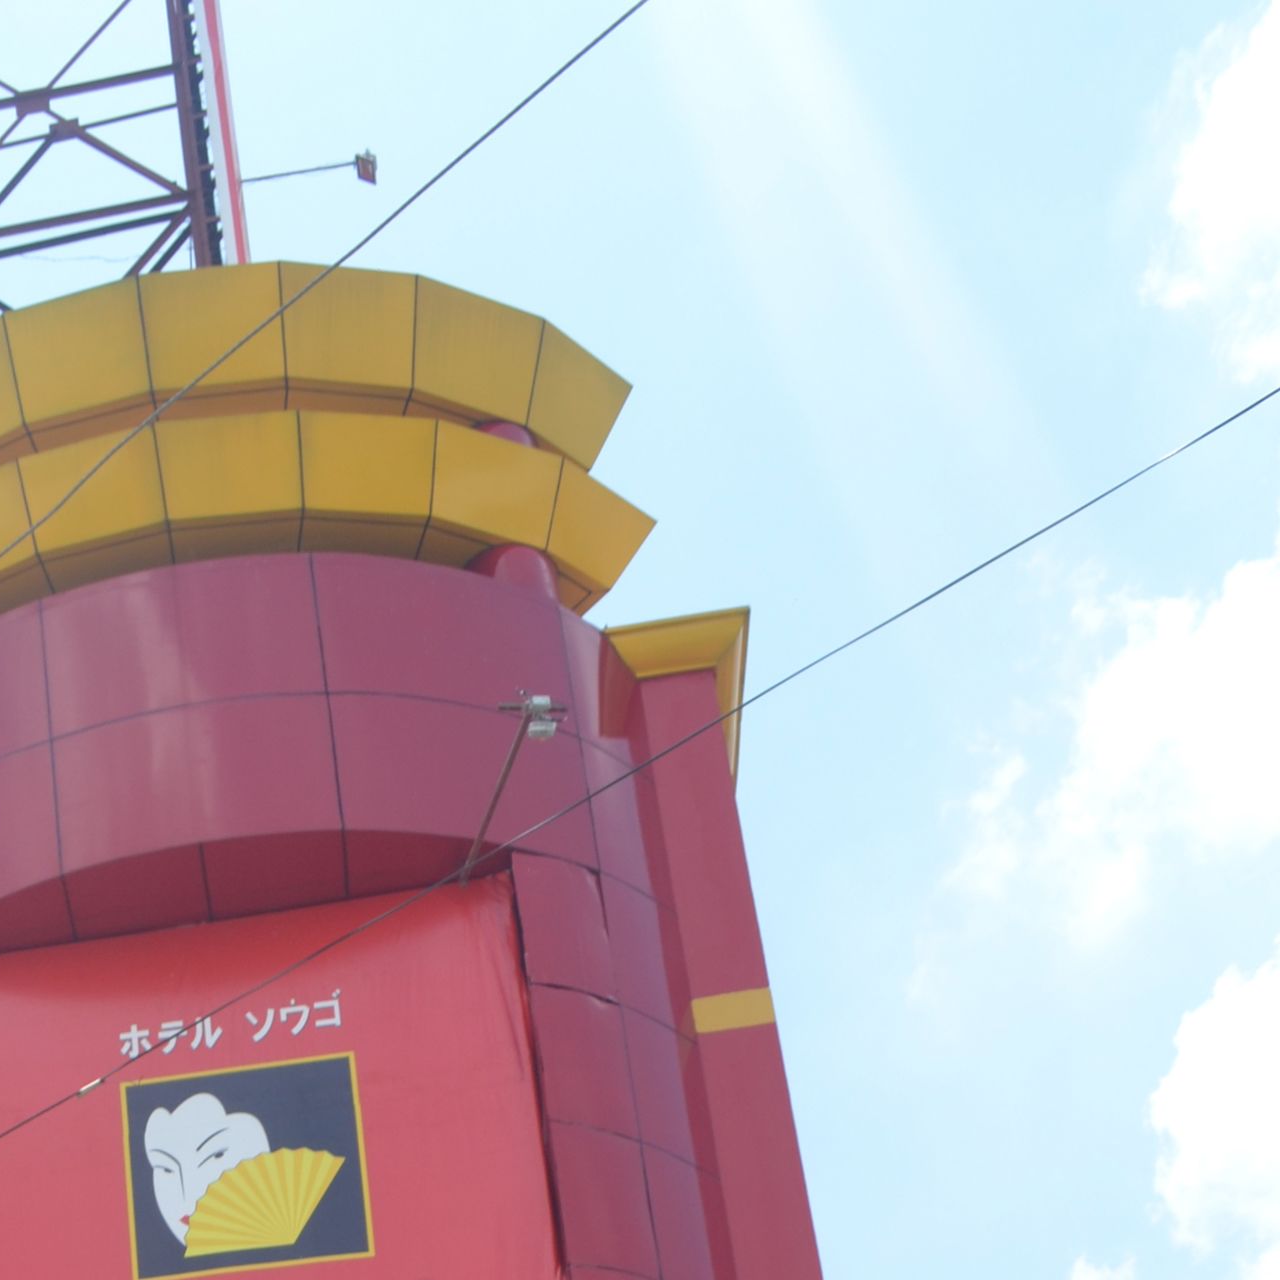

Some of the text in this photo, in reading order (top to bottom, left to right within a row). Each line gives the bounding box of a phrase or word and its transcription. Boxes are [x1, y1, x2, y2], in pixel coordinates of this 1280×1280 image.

[119, 988, 342, 1059] ホテル ソウゴ
